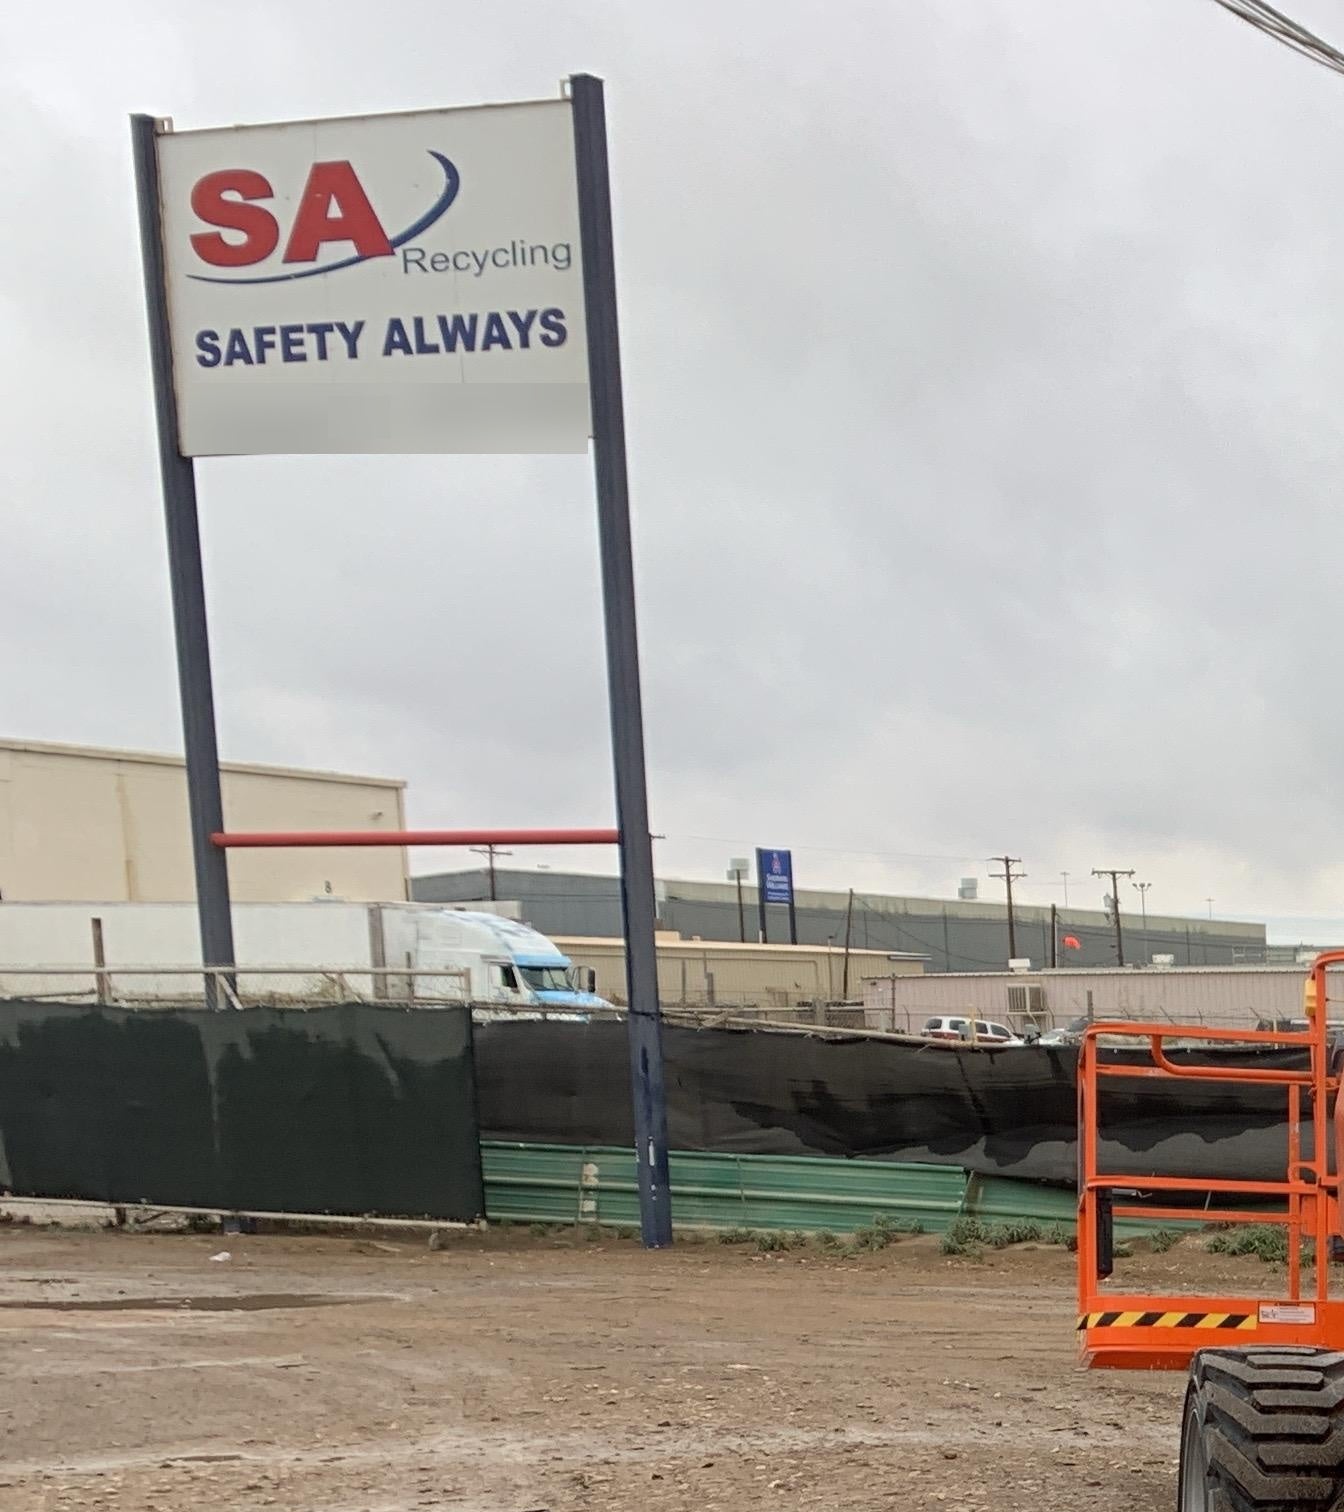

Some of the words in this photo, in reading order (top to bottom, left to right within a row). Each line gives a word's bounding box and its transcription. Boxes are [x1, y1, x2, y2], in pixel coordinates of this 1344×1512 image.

[190, 159, 396, 268] SA
[402, 239, 571, 277] Recycling
[195, 320, 366, 368] SAFETY
[382, 307, 568, 357] ALWAYS
